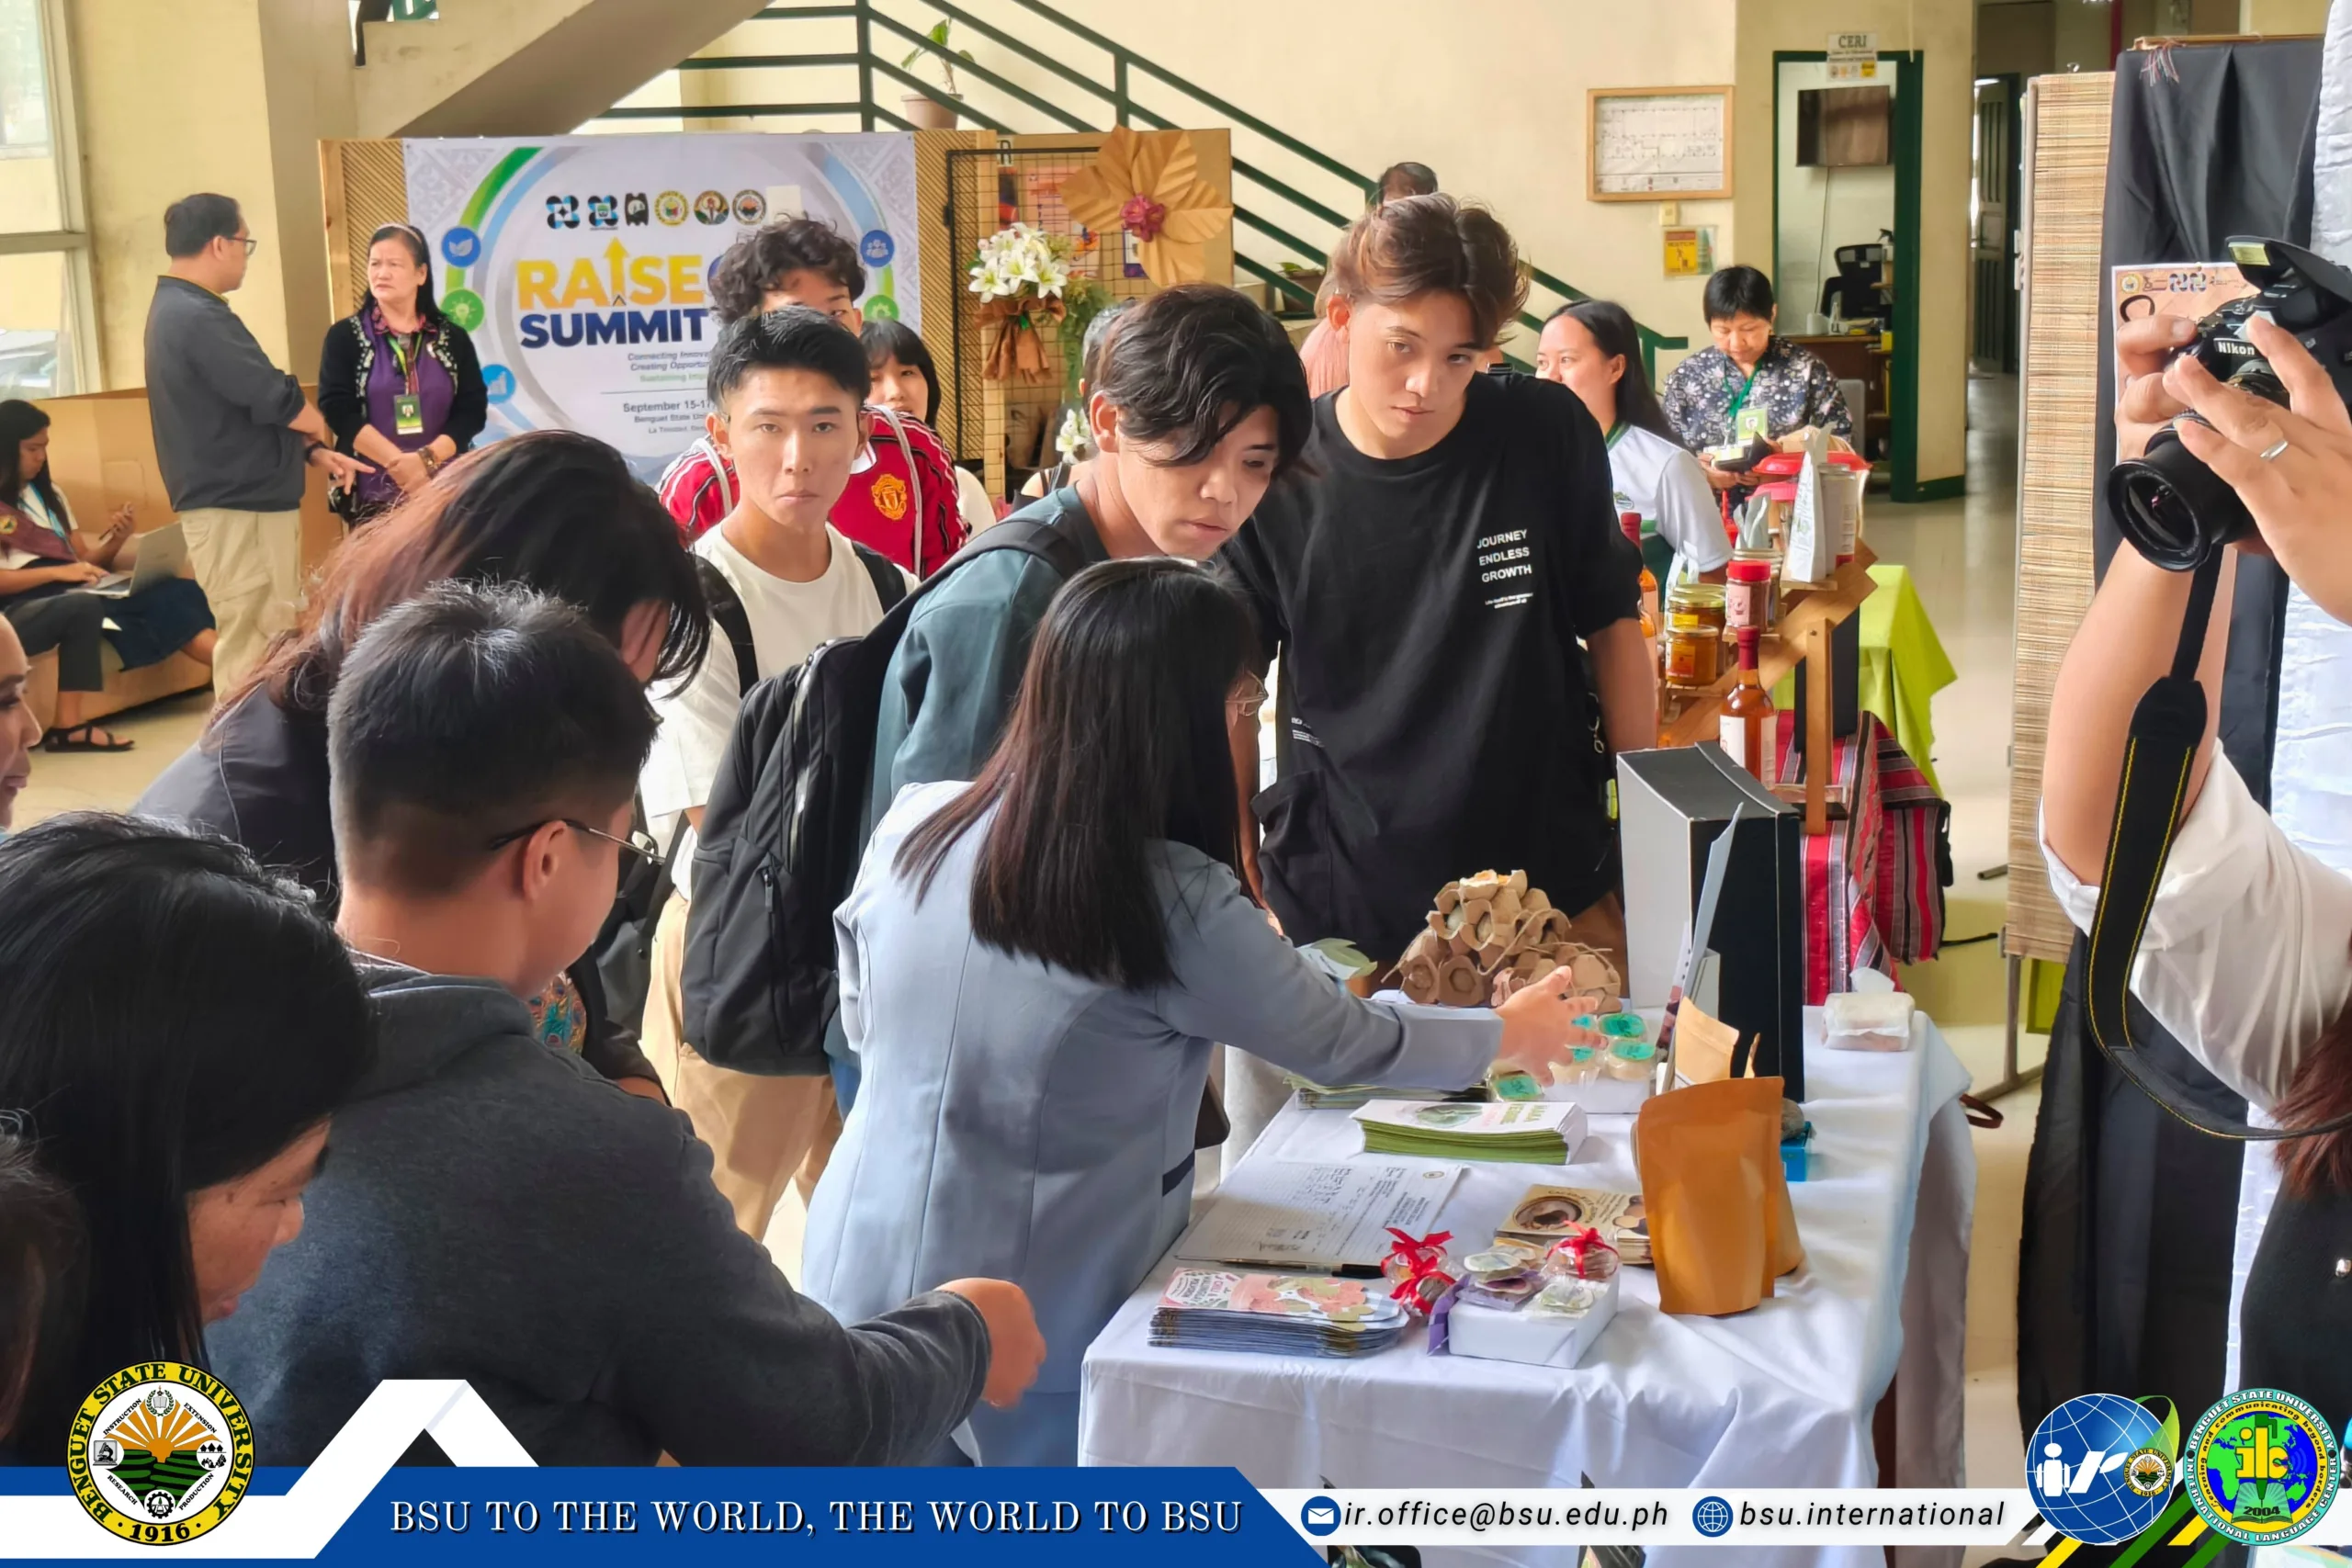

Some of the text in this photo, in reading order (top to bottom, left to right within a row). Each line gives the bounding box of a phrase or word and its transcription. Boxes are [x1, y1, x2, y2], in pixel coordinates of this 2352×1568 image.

[1838, 35, 1867, 49] CERI
[516, 236, 705, 310] RAISE
[520, 308, 709, 348] SUMMIT
[628, 352, 677, 361] Connecting
[2218, 342, 2256, 355] Nikon
[630, 363, 668, 371] Creating
[623, 401, 681, 413] September
[1476, 529, 1527, 549] JOURNEY
[1479, 547, 1530, 566] ENDLESS
[1481, 564, 1532, 582] GROWTH
